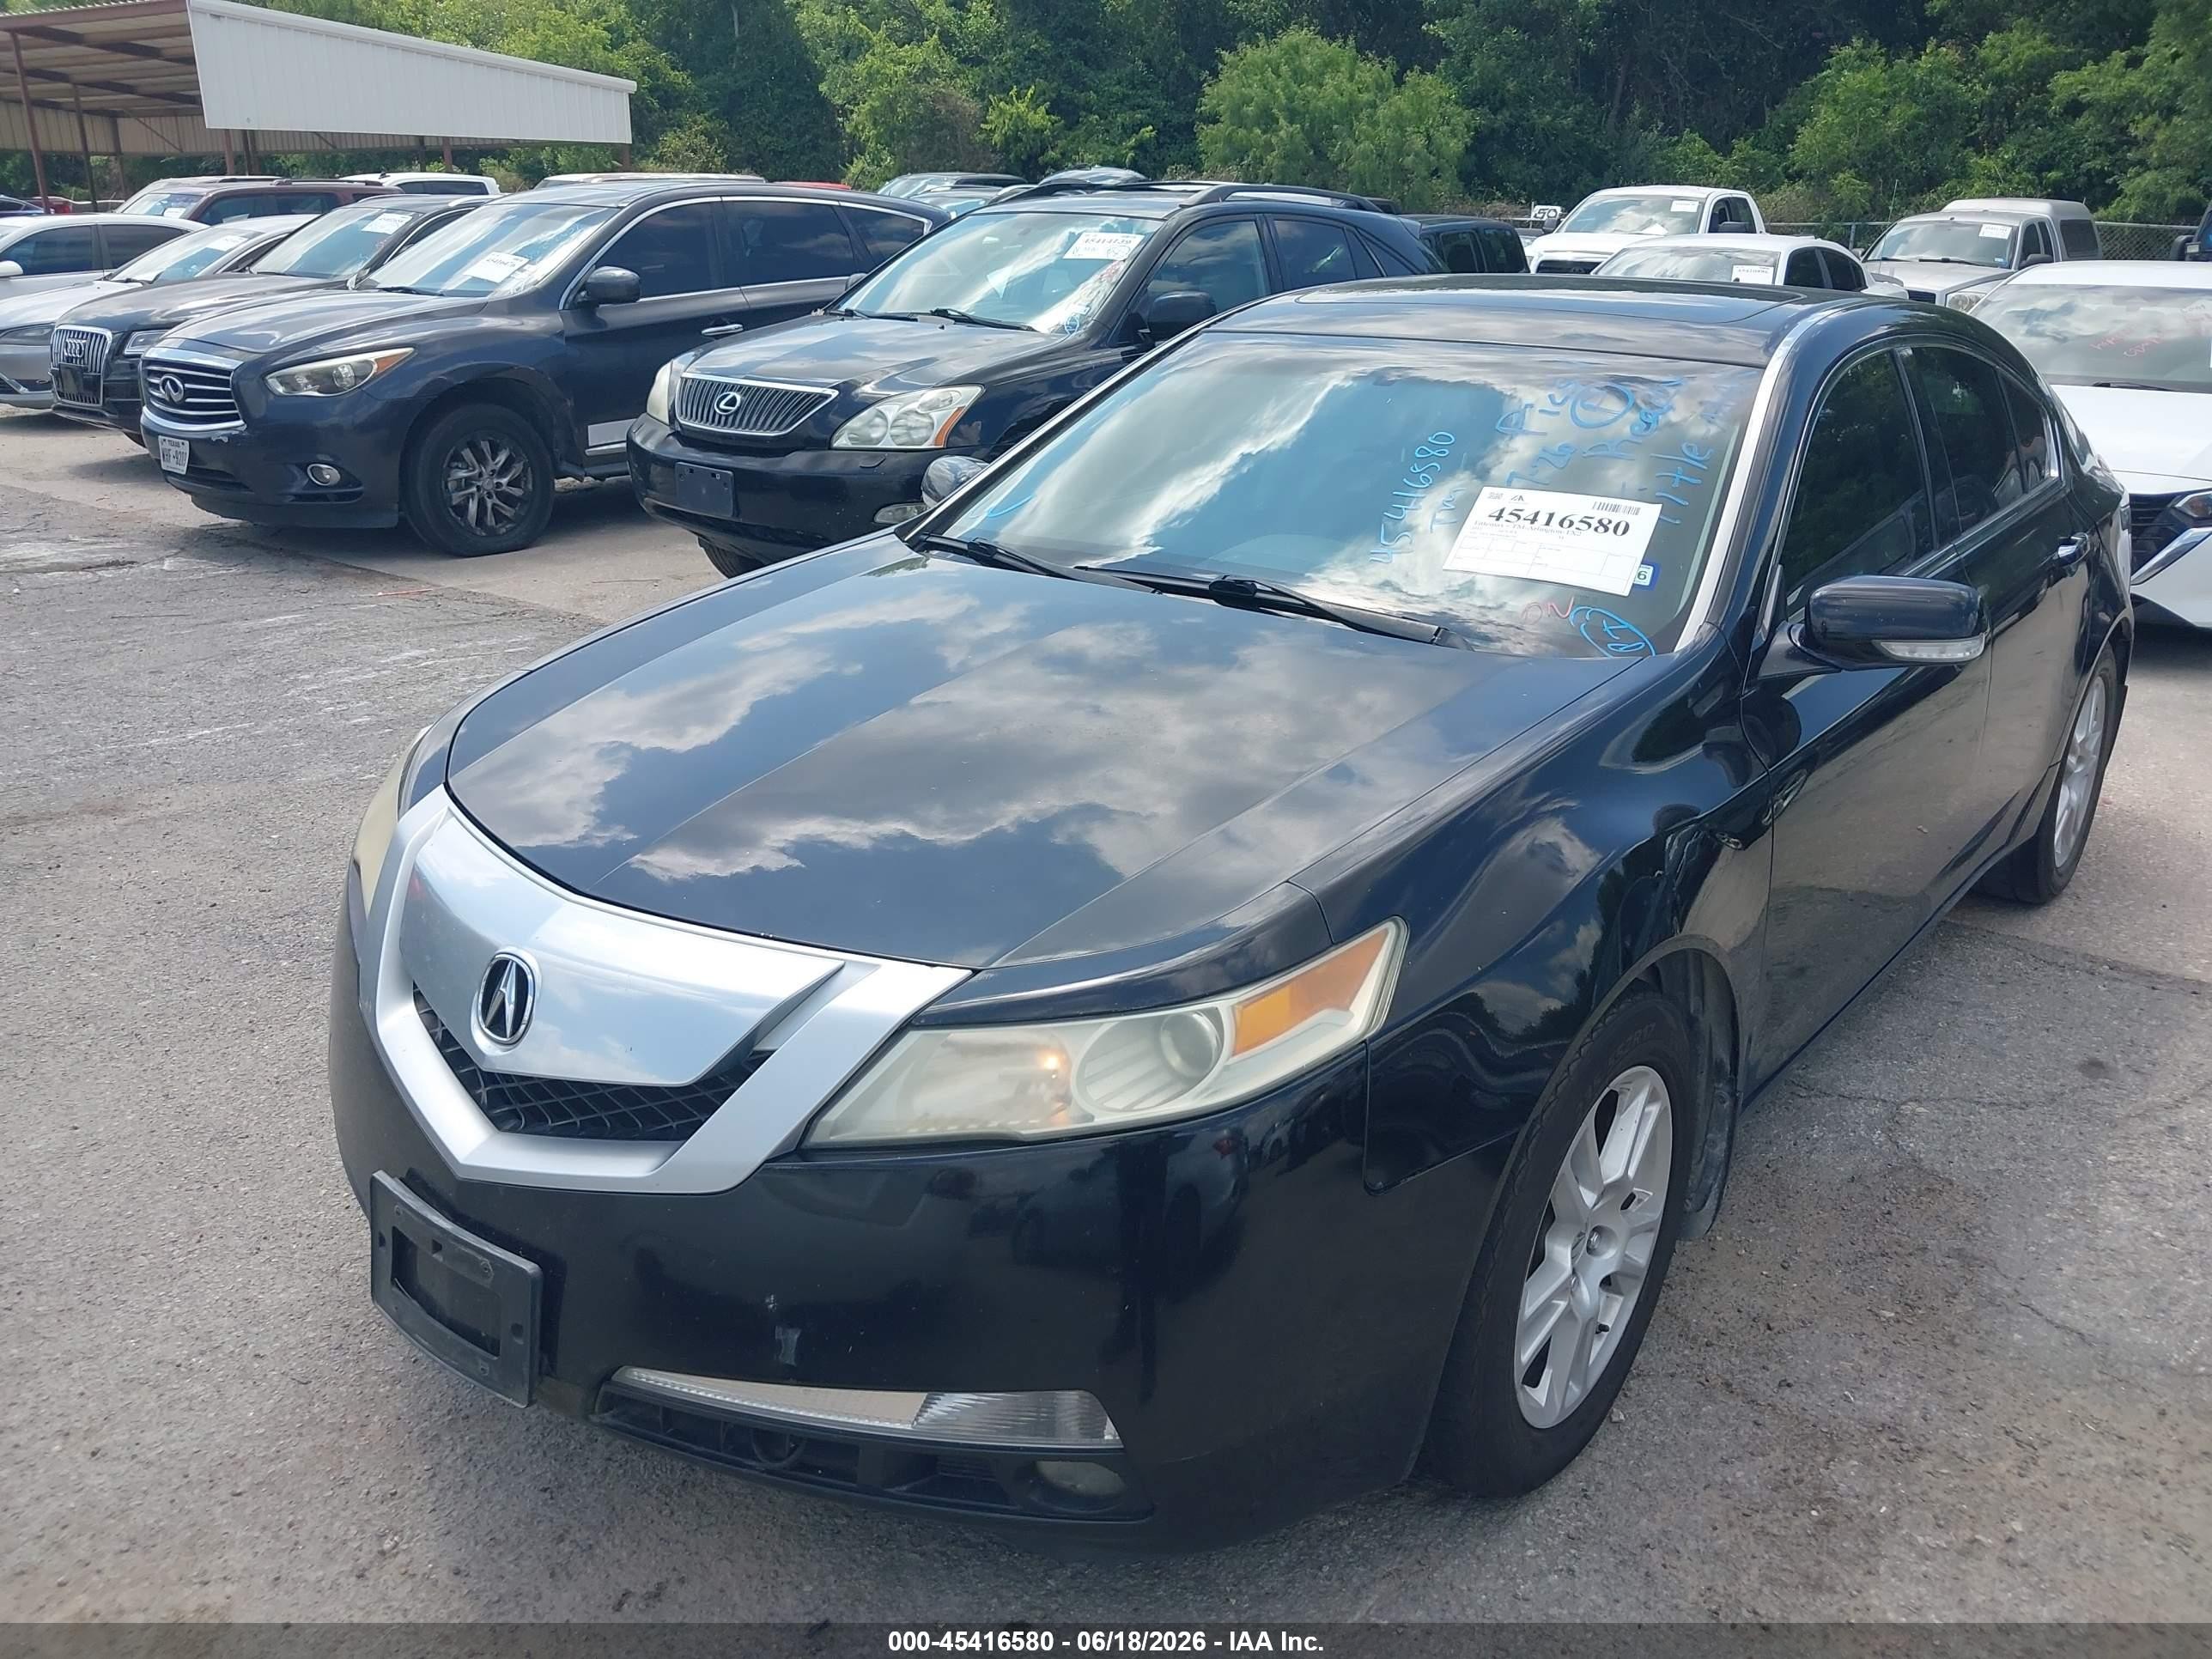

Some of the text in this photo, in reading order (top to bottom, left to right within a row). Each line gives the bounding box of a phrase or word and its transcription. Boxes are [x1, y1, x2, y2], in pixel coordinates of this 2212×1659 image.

[1534, 208, 1558, 219] 50
[1369, 431, 1455, 564] 45416580
[1487, 507, 1631, 537] 45416580
